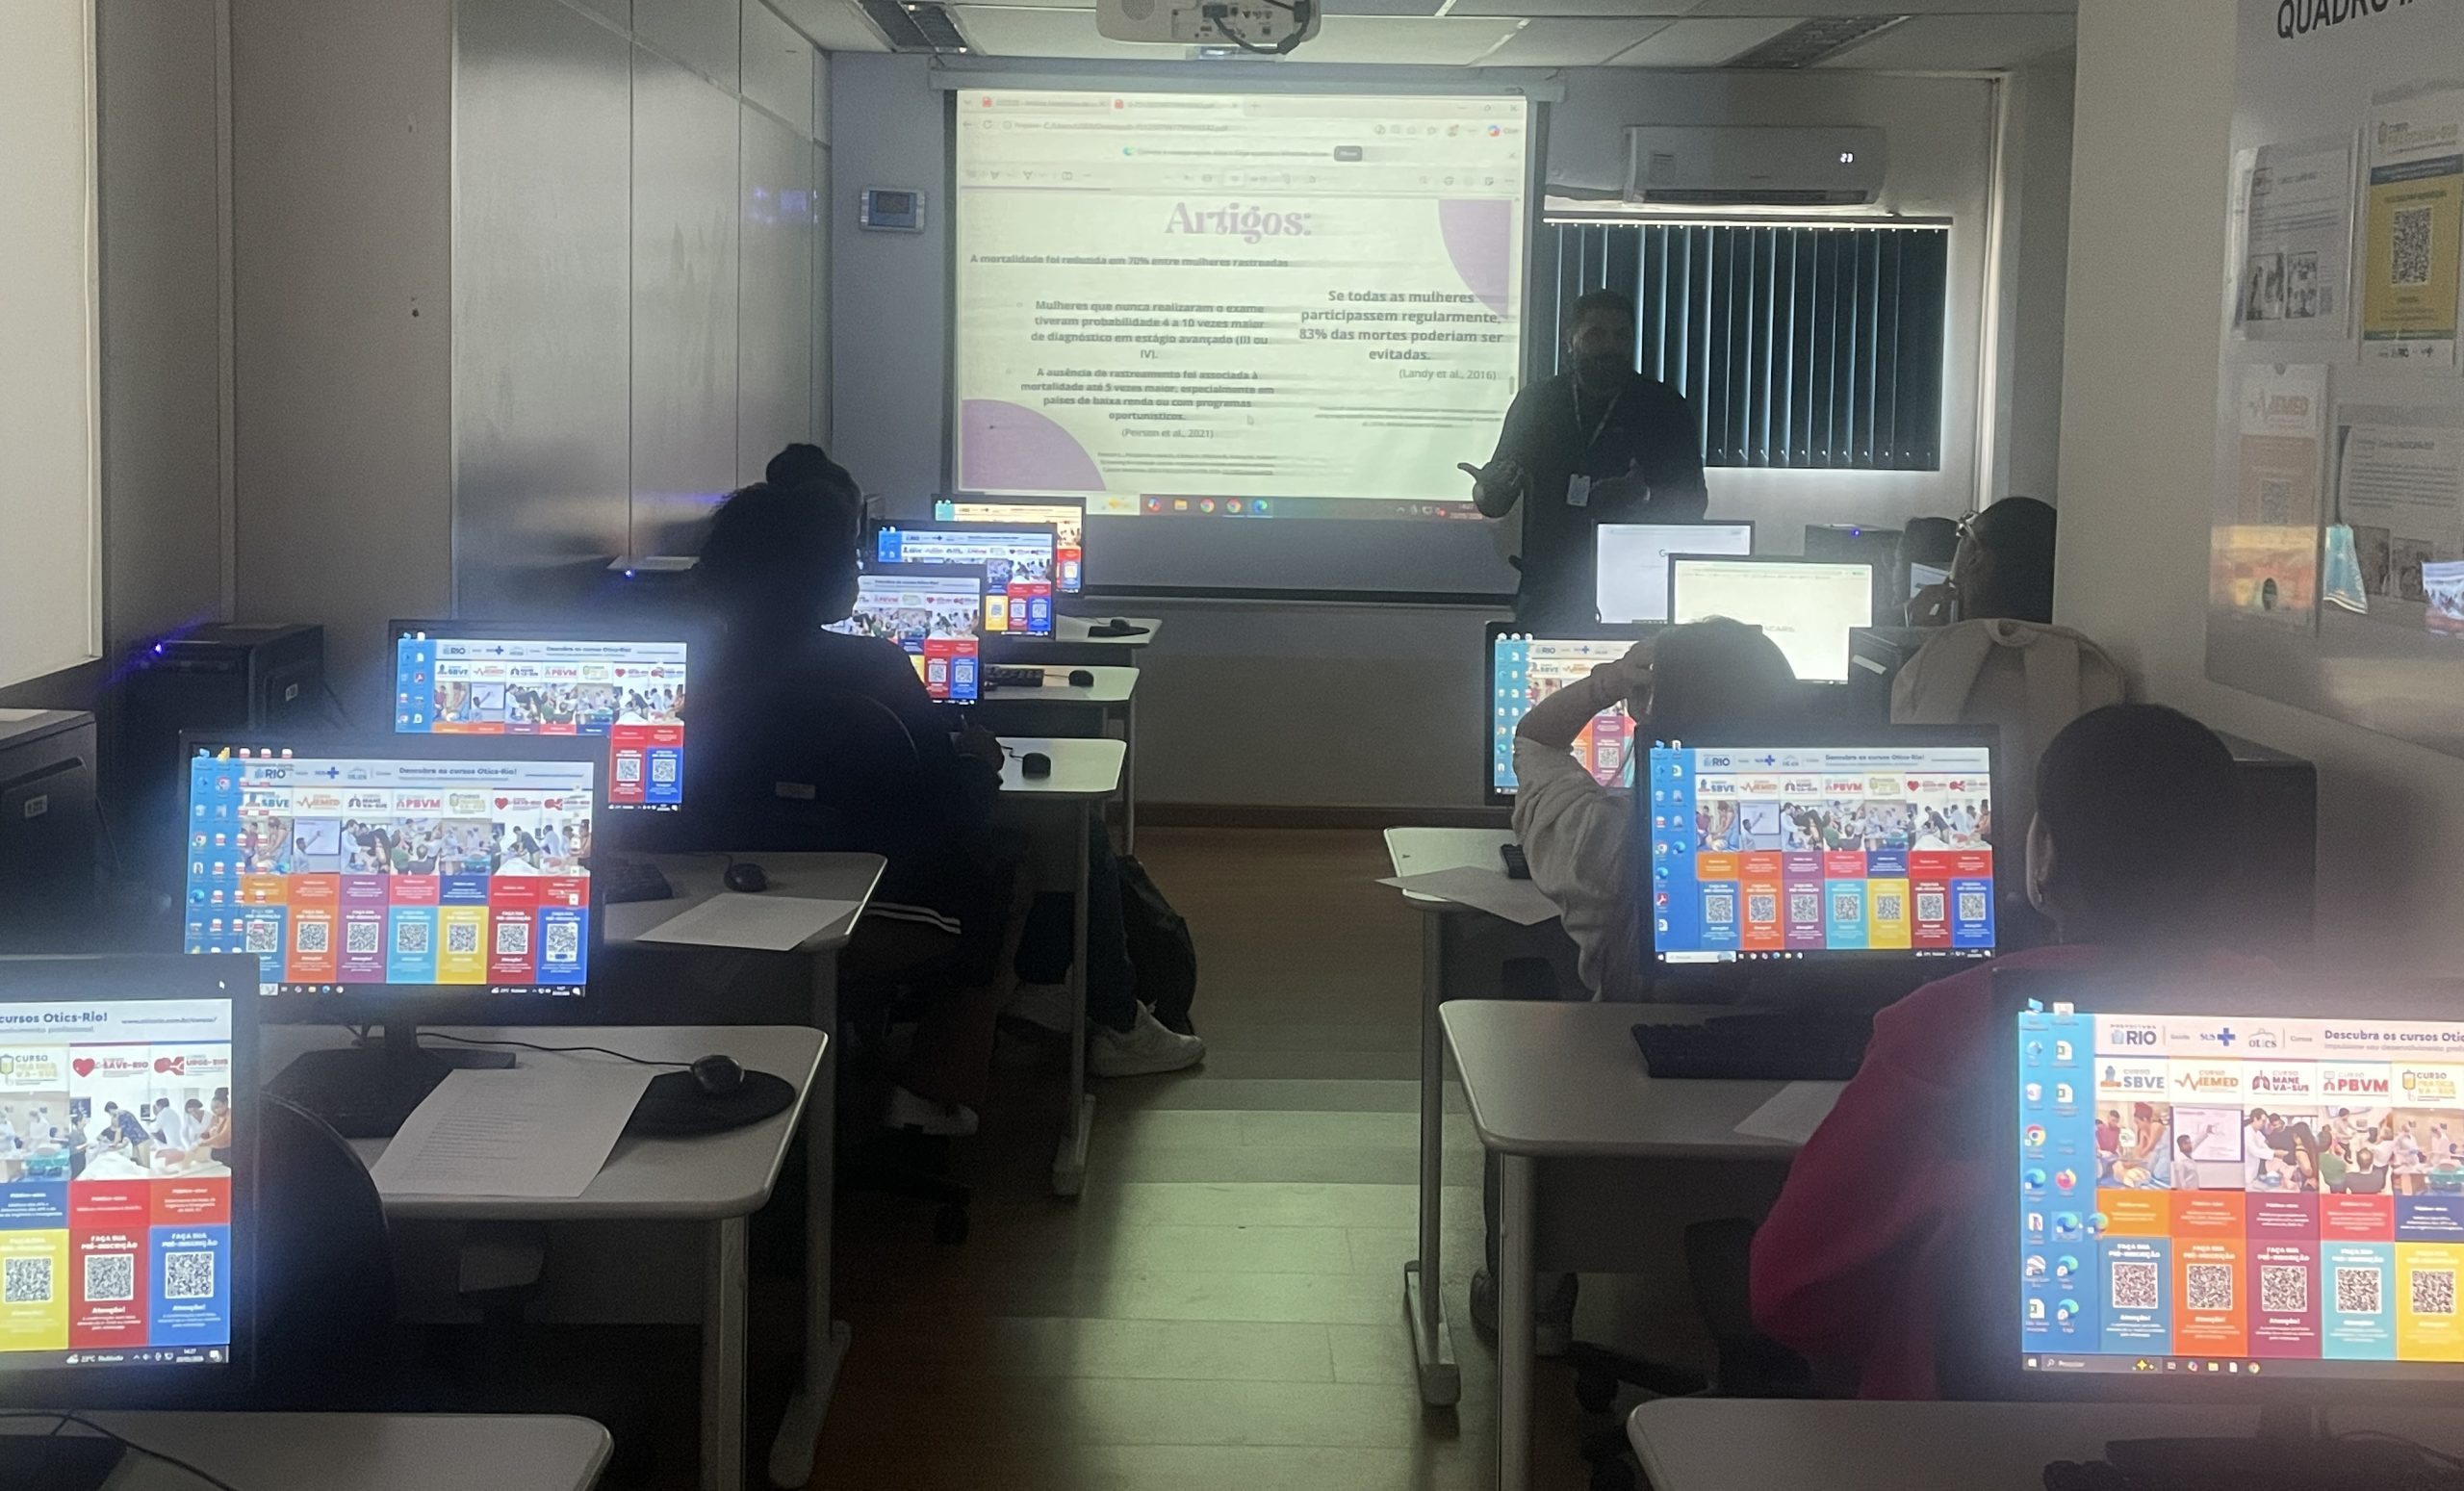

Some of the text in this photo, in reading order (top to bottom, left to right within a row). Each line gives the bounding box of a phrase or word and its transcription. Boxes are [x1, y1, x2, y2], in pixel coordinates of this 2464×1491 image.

[1164, 202, 1312, 244] Artigos:
[980, 254, 1043, 264] mortalidade
[1045, 255, 1060, 264] foi
[1128, 257, 1149, 266] 70%
[1182, 257, 1231, 267] mulheres
[1328, 290, 1475, 303] Se todas as mulheres
[1035, 300, 1089, 312] Mulheres
[1091, 303, 1113, 314] que
[1115, 303, 1150, 313] nunca
[1152, 302, 1214, 313] realizaram
[1226, 305, 1265, 314] exame
[1035, 316, 1079, 327] tiveram
[1081, 317, 1162, 329] probabilidade
[1182, 319, 1195, 327] 10
[1231, 320, 1265, 329] maior
[1301, 309, 1502, 325] participassem regularmente,
[1031, 332, 1044, 342] de
[1046, 332, 1112, 345] diagnóstico
[1115, 334, 1132, 343] em
[1135, 333, 1176, 346] estágio
[1178, 334, 1233, 347] avançado
[1299, 328, 1503, 344] 83% das mortes poderiam ser
[1369, 348, 1431, 360] evitadas.
[1037, 368, 1044, 376] A
[1046, 368, 1091, 378] ausência
[1094, 369, 1107, 377] de
[1110, 370, 1181, 379] rastreamento
[1183, 370, 1196, 379] foi
[1199, 371, 1249, 380] associada
[1399, 369, 1434, 381] (Landy
[1437, 370, 1448, 379] et
[1467, 370, 1497, 380] 2016)
[1020, 382, 1084, 392] mortalidade
[1086, 382, 1104, 392] até
[1114, 384, 1142, 393] vezes
[1180, 385, 1256, 396] especialmente
[1077, 396, 1091, 405] de
[1092, 397, 1121, 406] baixa
[1123, 397, 1153, 406] renda
[1171, 398, 1194, 407] com
[1195, 399, 1252, 410] programas
[1712, 757, 1731, 767] RIO
[265, 769, 286, 780] RIO
[406, 798, 441, 808] PBVM
[43, 1011, 108, 1023] Otics-Rio!
[2126, 1030, 2157, 1045] RIO
[2324, 1029, 2379, 1041] Descubra
[2383, 1032, 2397, 1041] os
[2400, 1032, 2439, 1041] cursos
[2123, 1076, 2165, 1089] SBVE
[2337, 1078, 2389, 1093] PBVM
